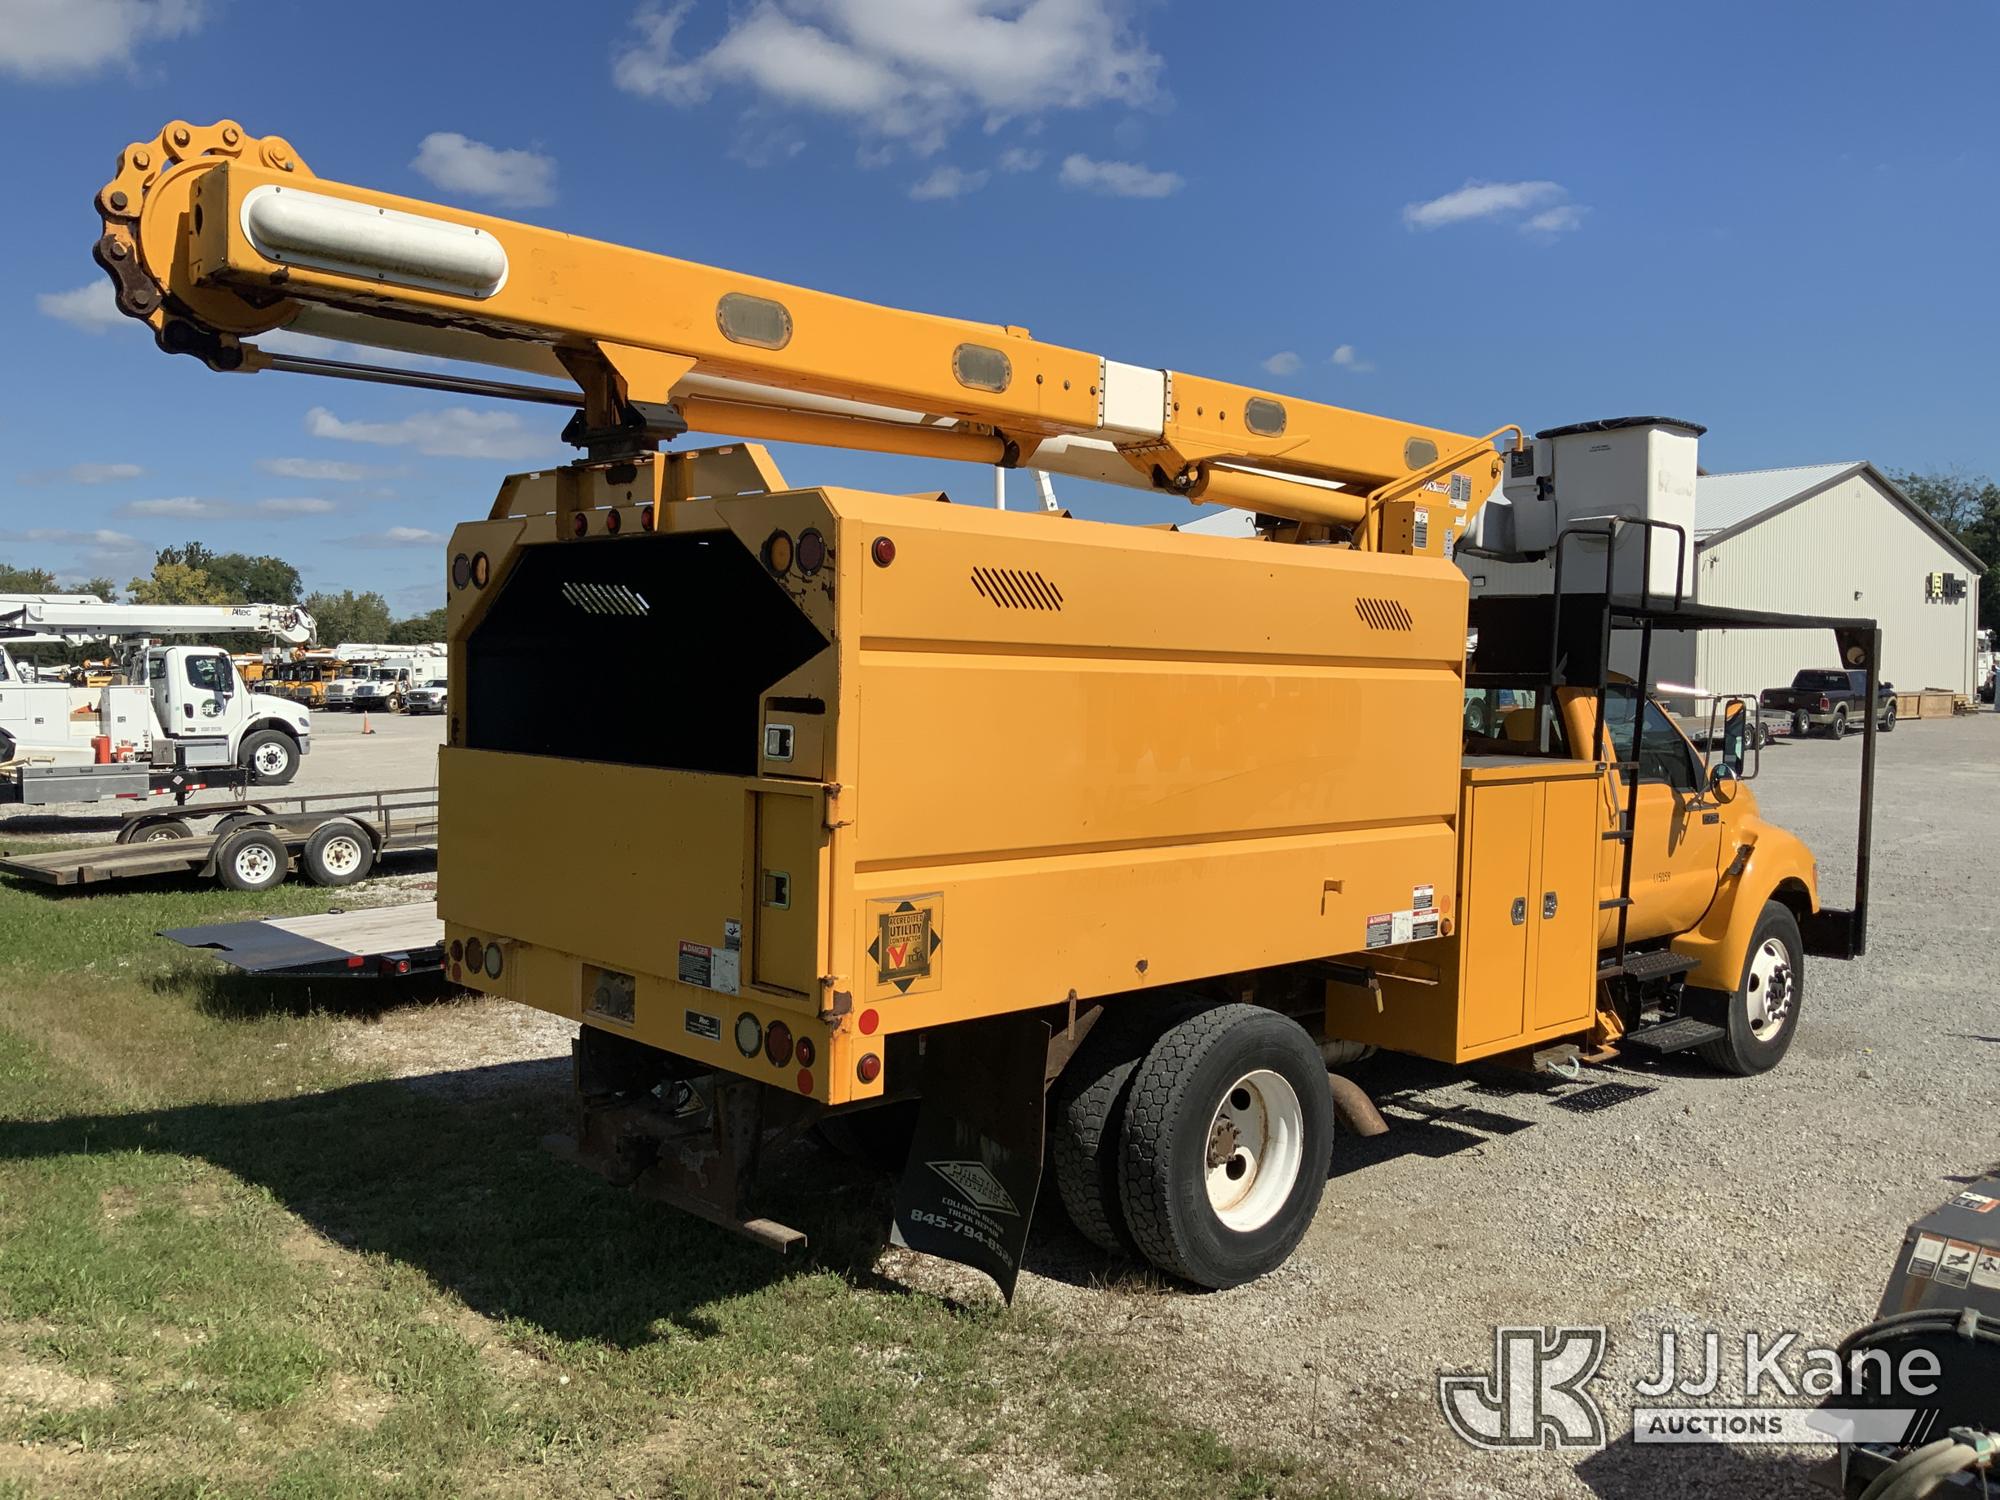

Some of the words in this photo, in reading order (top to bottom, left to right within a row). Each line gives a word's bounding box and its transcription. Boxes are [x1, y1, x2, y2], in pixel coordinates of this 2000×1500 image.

[889, 915, 923, 926] ACCREDITED
[890, 923, 922, 937] UTILITY
[942, 1197, 980, 1218] COLLISION
[948, 1208, 973, 1224] TRUCK
[975, 1220, 999, 1239] REPAIR
